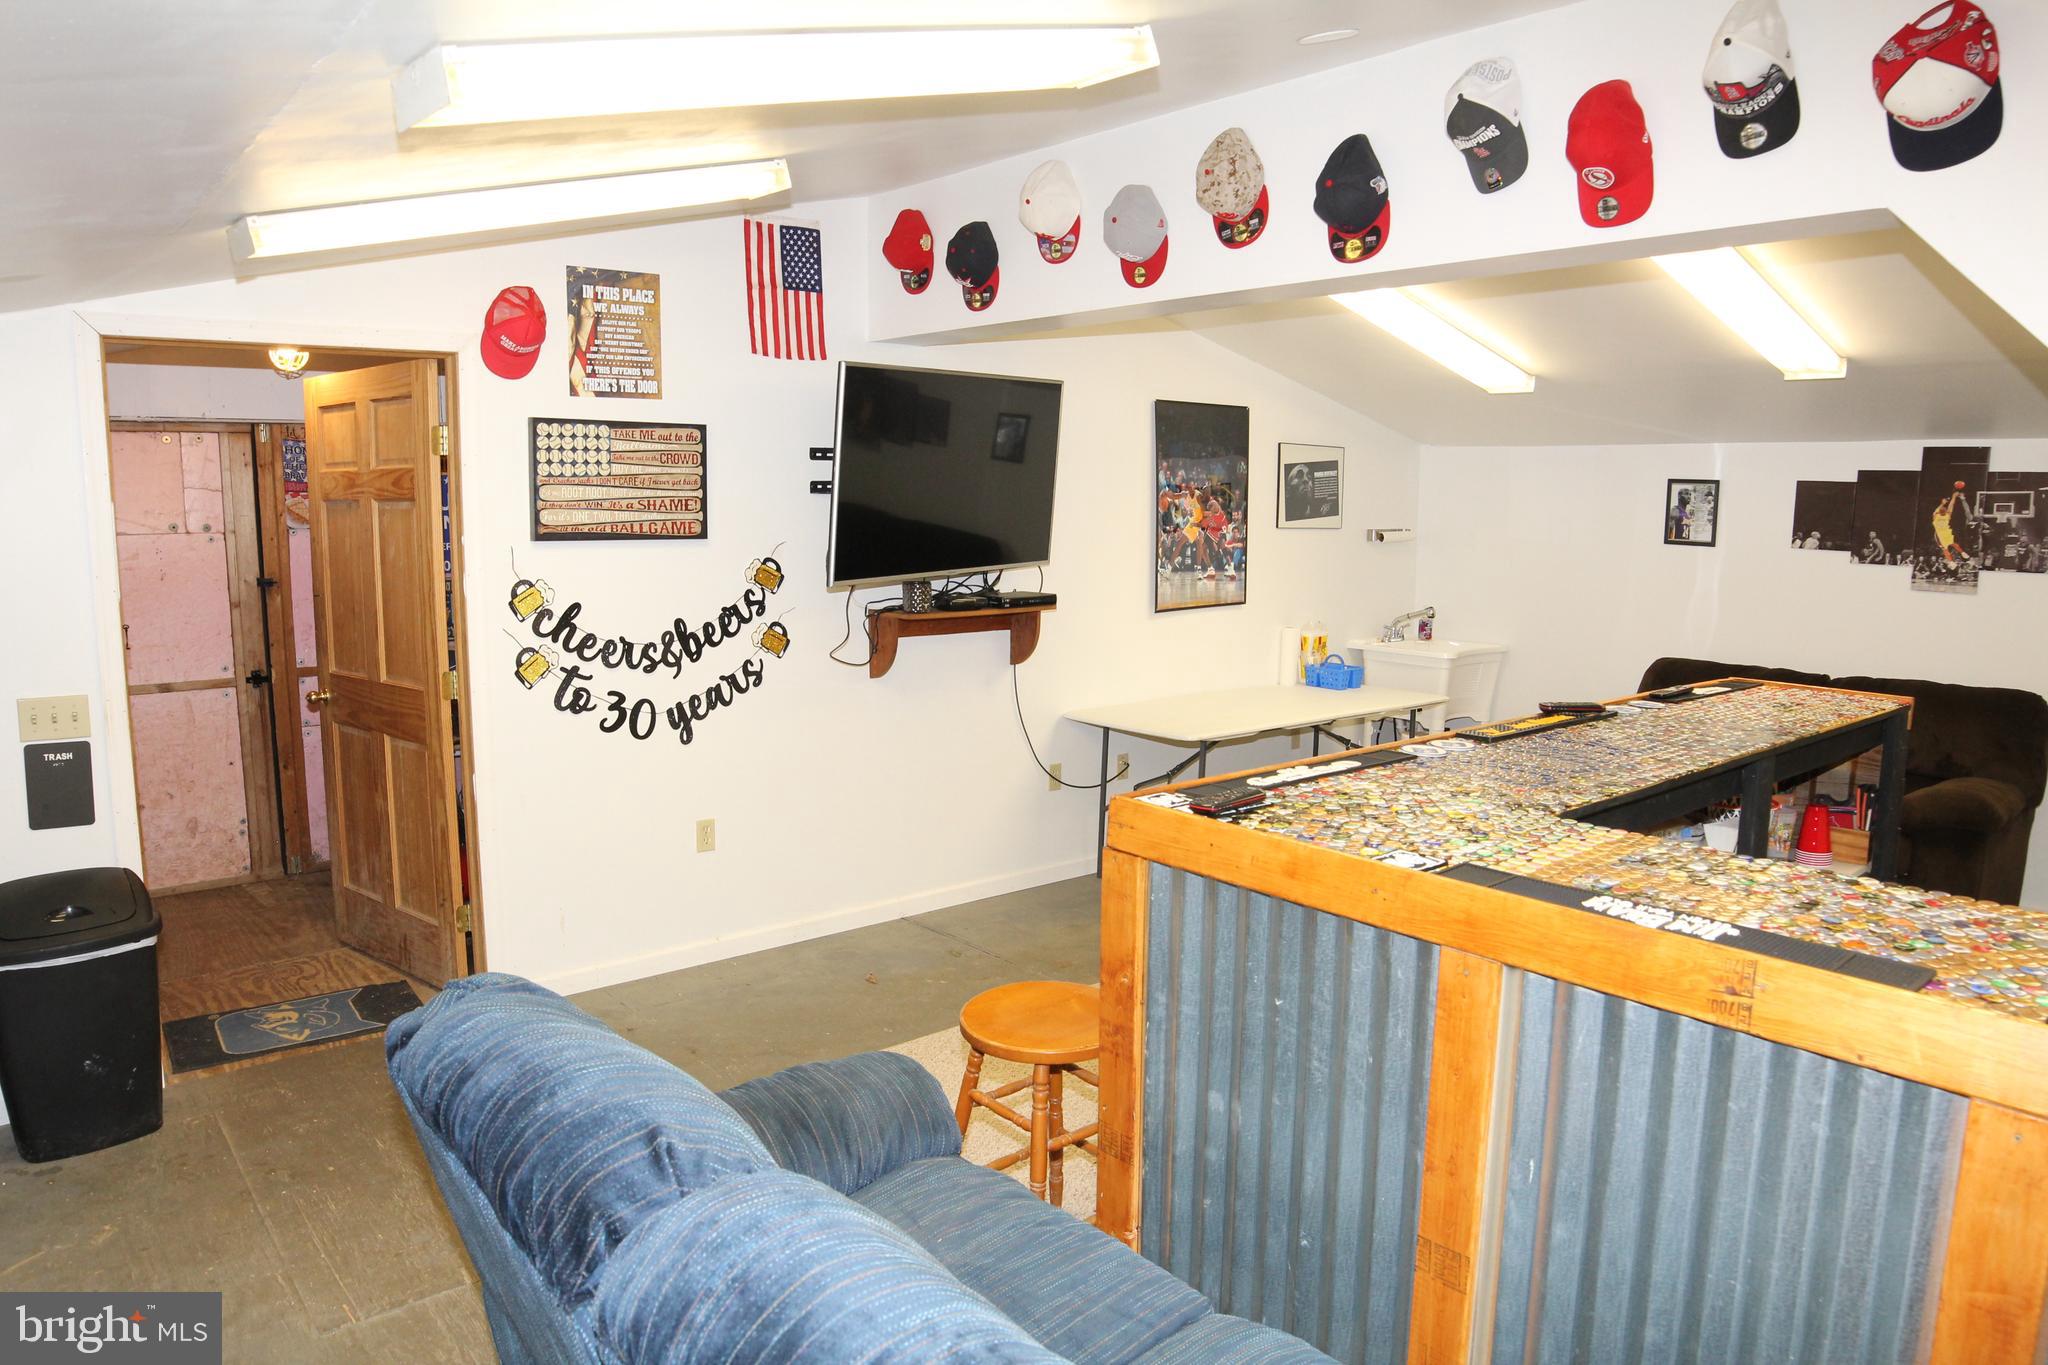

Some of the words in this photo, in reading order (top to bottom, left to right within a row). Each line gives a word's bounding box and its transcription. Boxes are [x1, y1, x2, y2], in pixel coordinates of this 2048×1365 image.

[582, 284, 594, 298] IN
[596, 286, 620, 301] THIS
[622, 288, 654, 304] PLACE
[593, 302, 608, 312] WE
[610, 304, 644, 316] ALWAYS
[586, 366, 593, 374] IF
[594, 366, 610, 374] THIS
[612, 367, 640, 375] OFFENDS
[583, 378, 617, 392] THERE'S
[619, 379, 636, 392] THE
[638, 381, 658, 393] DOOR
[613, 429, 636, 439] TAKE
[640, 430, 656, 440] ME
[674, 432, 683, 442] to
[685, 432, 698, 442] the
[660, 453, 699, 465] CROWD
[619, 477, 638, 486] CARE
[638, 499, 697, 511] SHAME!
[610, 521, 697, 534] BALLGAME
[554, 666, 597, 714] to
[599, 690, 656, 740] 30
[666, 658, 764, 745] years
[43, 752, 73, 761] TRASH
